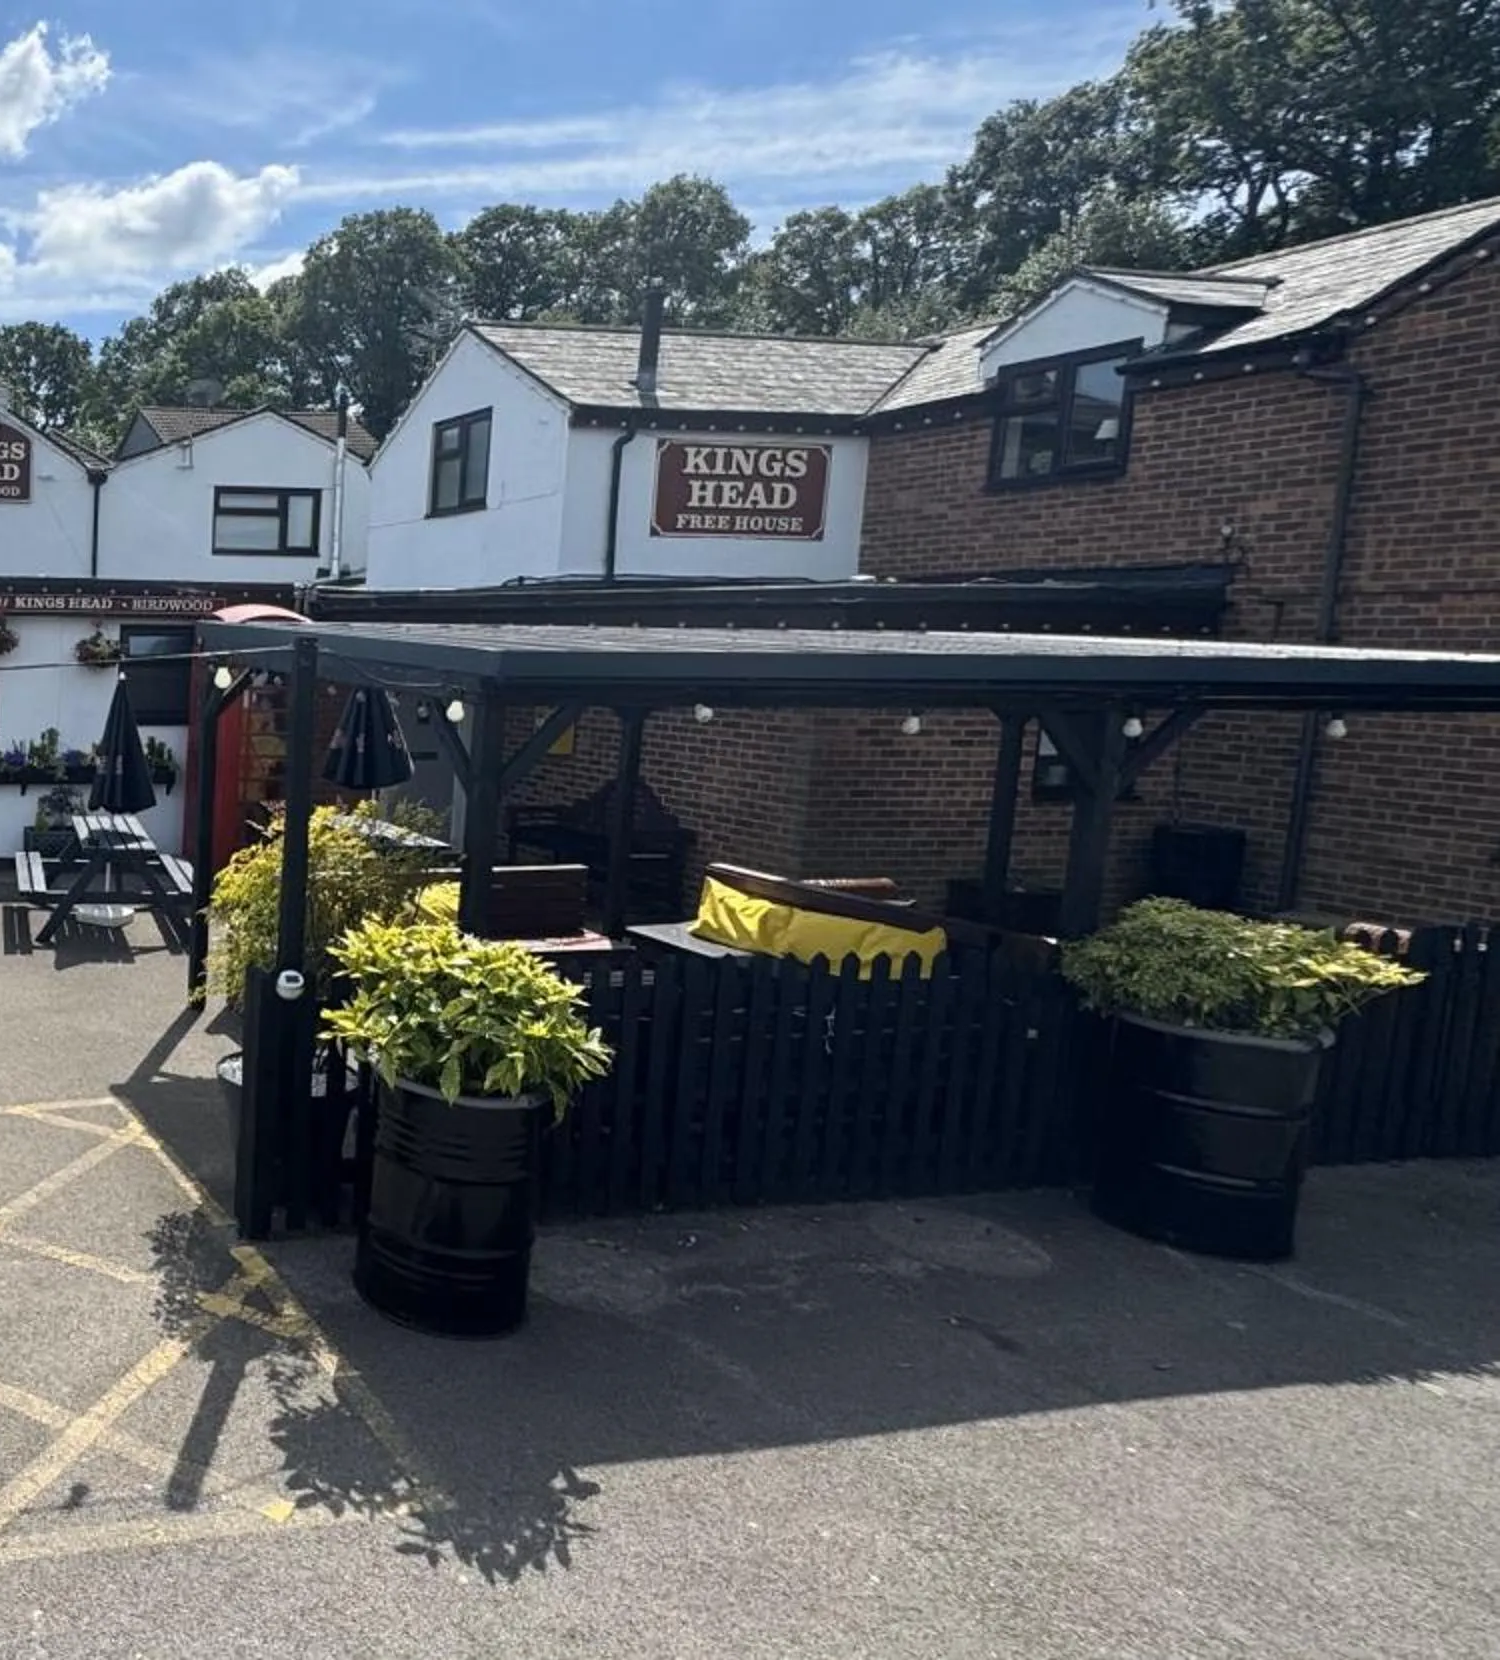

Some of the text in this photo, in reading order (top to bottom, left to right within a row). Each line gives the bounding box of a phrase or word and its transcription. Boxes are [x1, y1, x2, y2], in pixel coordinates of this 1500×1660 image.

[681, 447, 808, 478] KINGS
[686, 480, 798, 510] HEAD
[675, 513, 804, 532] FREE HOUSE
[13, 596, 214, 611] KINGS HEAD BIRDWOOD
